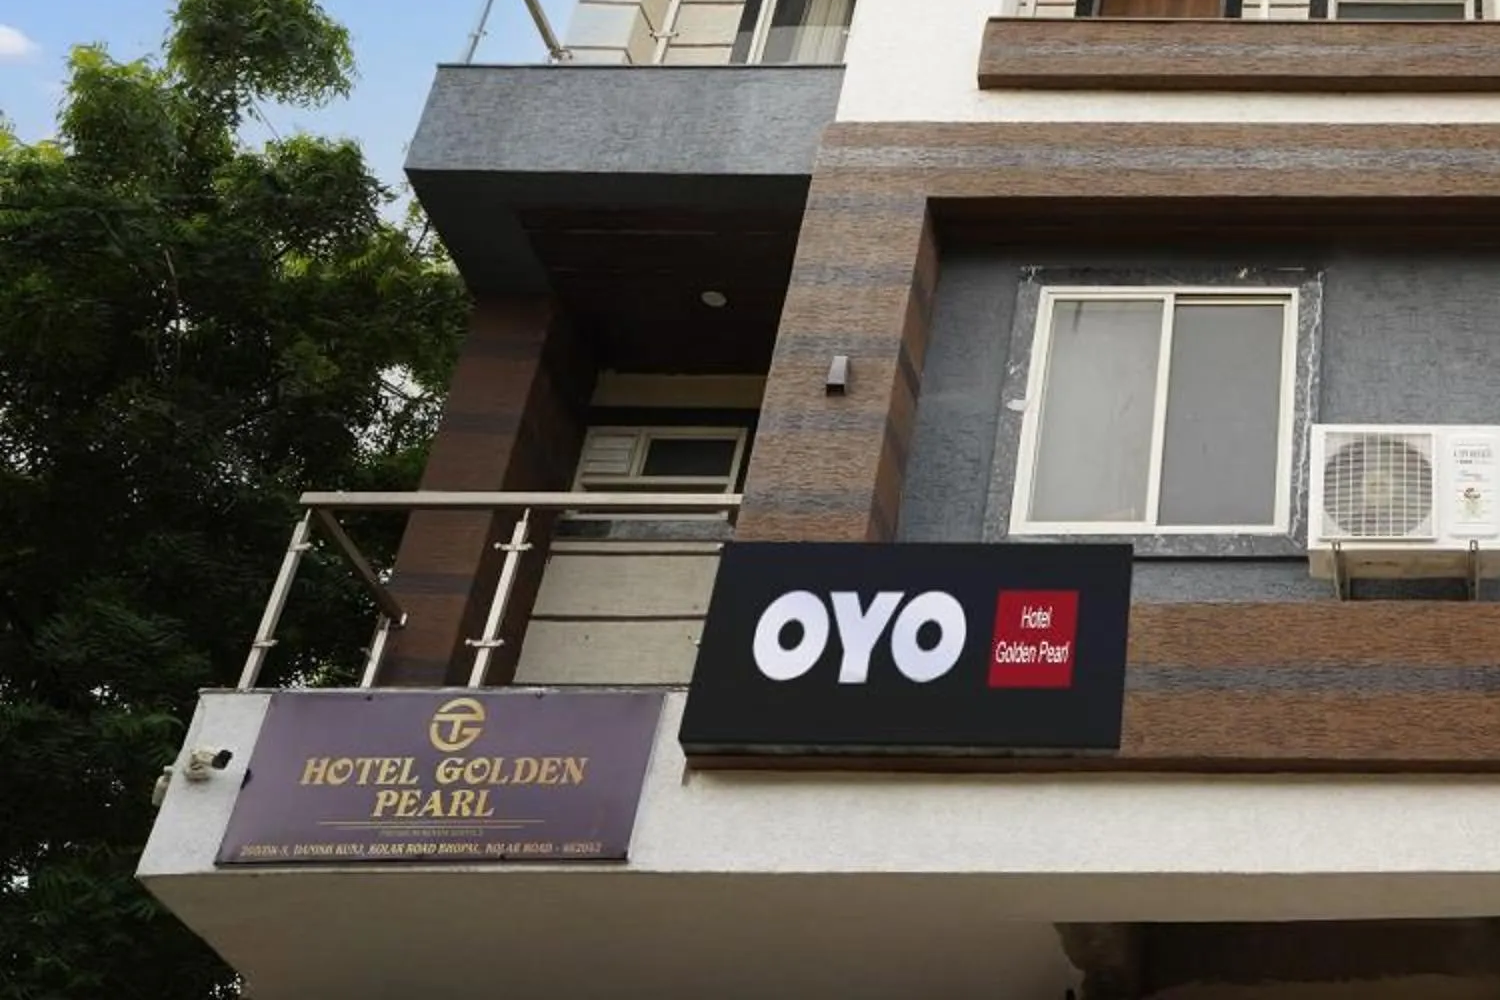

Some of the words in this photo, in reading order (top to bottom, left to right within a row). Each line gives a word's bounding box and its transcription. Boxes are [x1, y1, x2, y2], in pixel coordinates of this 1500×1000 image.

[1020, 605, 1053, 629] Hotel
[753, 590, 967, 684] OYO
[995, 641, 1037, 663] Golden
[1038, 640, 1071, 663] Pearl
[300, 757, 419, 786] HOTEL
[434, 757, 588, 786] GOLDEN
[369, 788, 496, 818] PEARL
